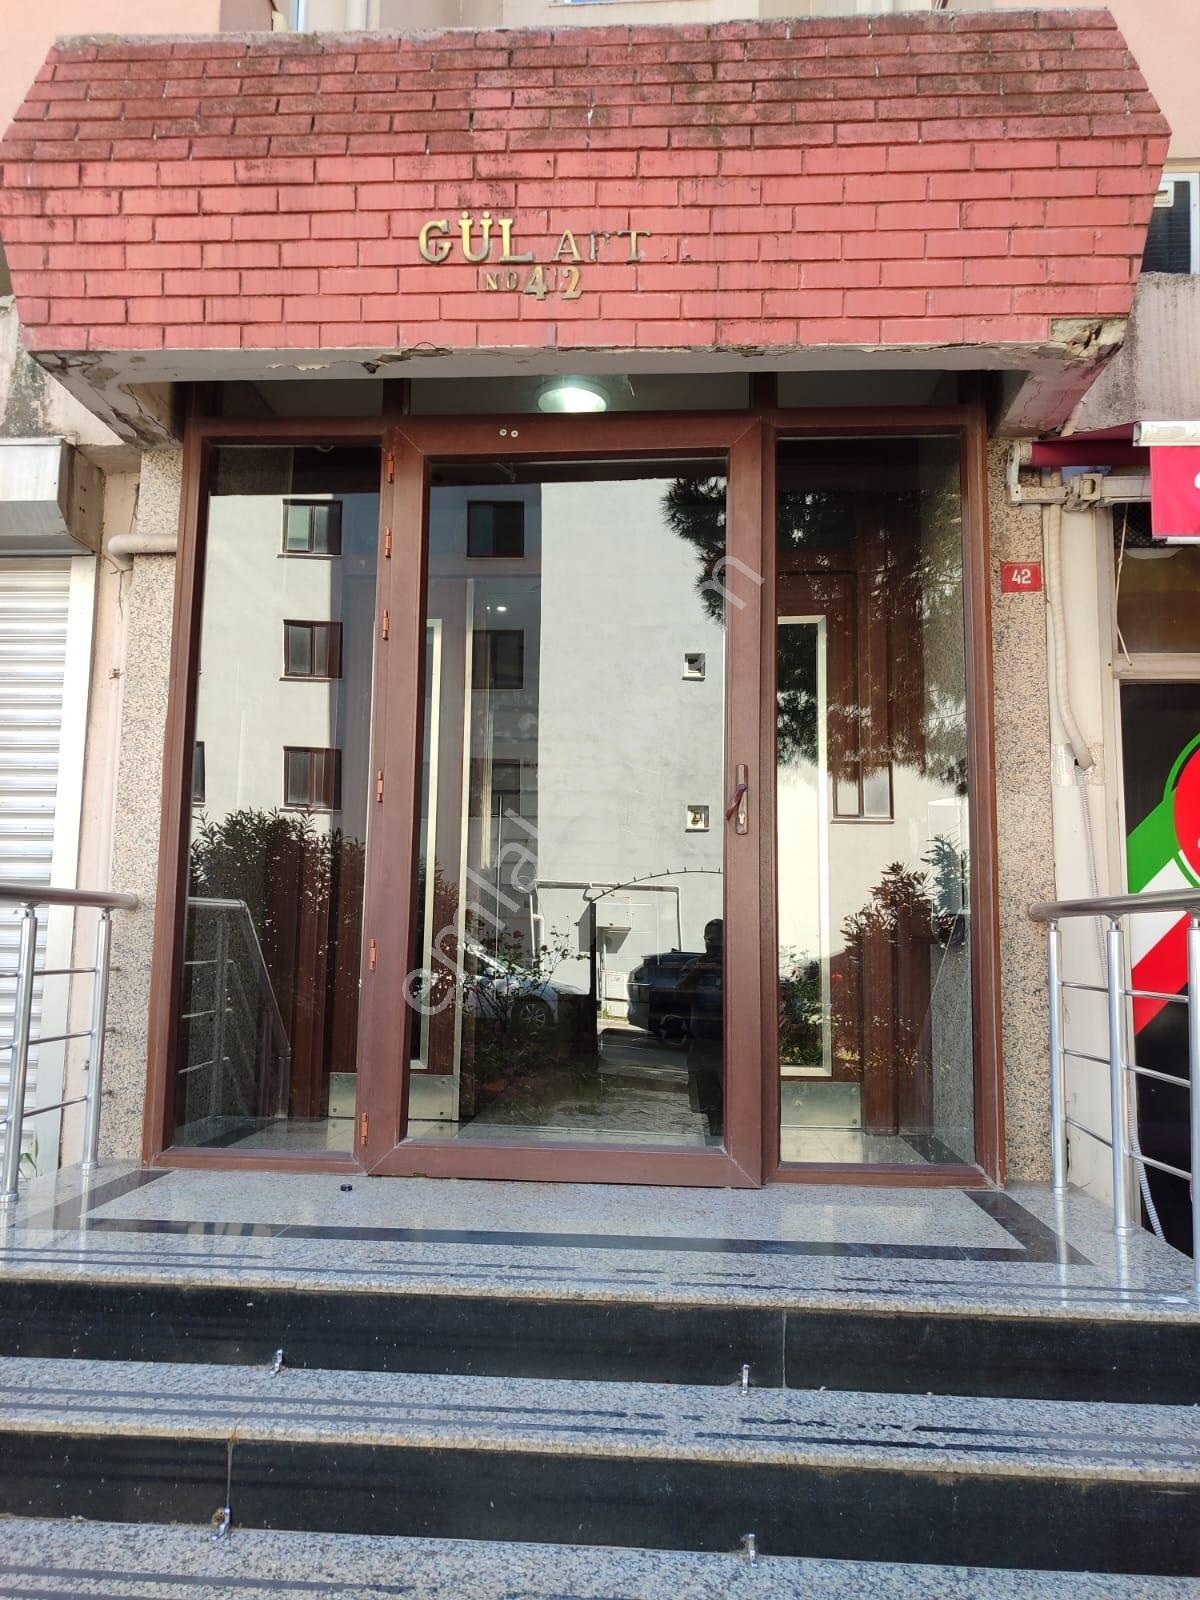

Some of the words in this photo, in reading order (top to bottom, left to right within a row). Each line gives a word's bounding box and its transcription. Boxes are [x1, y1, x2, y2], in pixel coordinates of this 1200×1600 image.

[418, 210, 535, 264] GÜL
[522, 264, 583, 301] 42
[1011, 568, 1032, 585] 42
